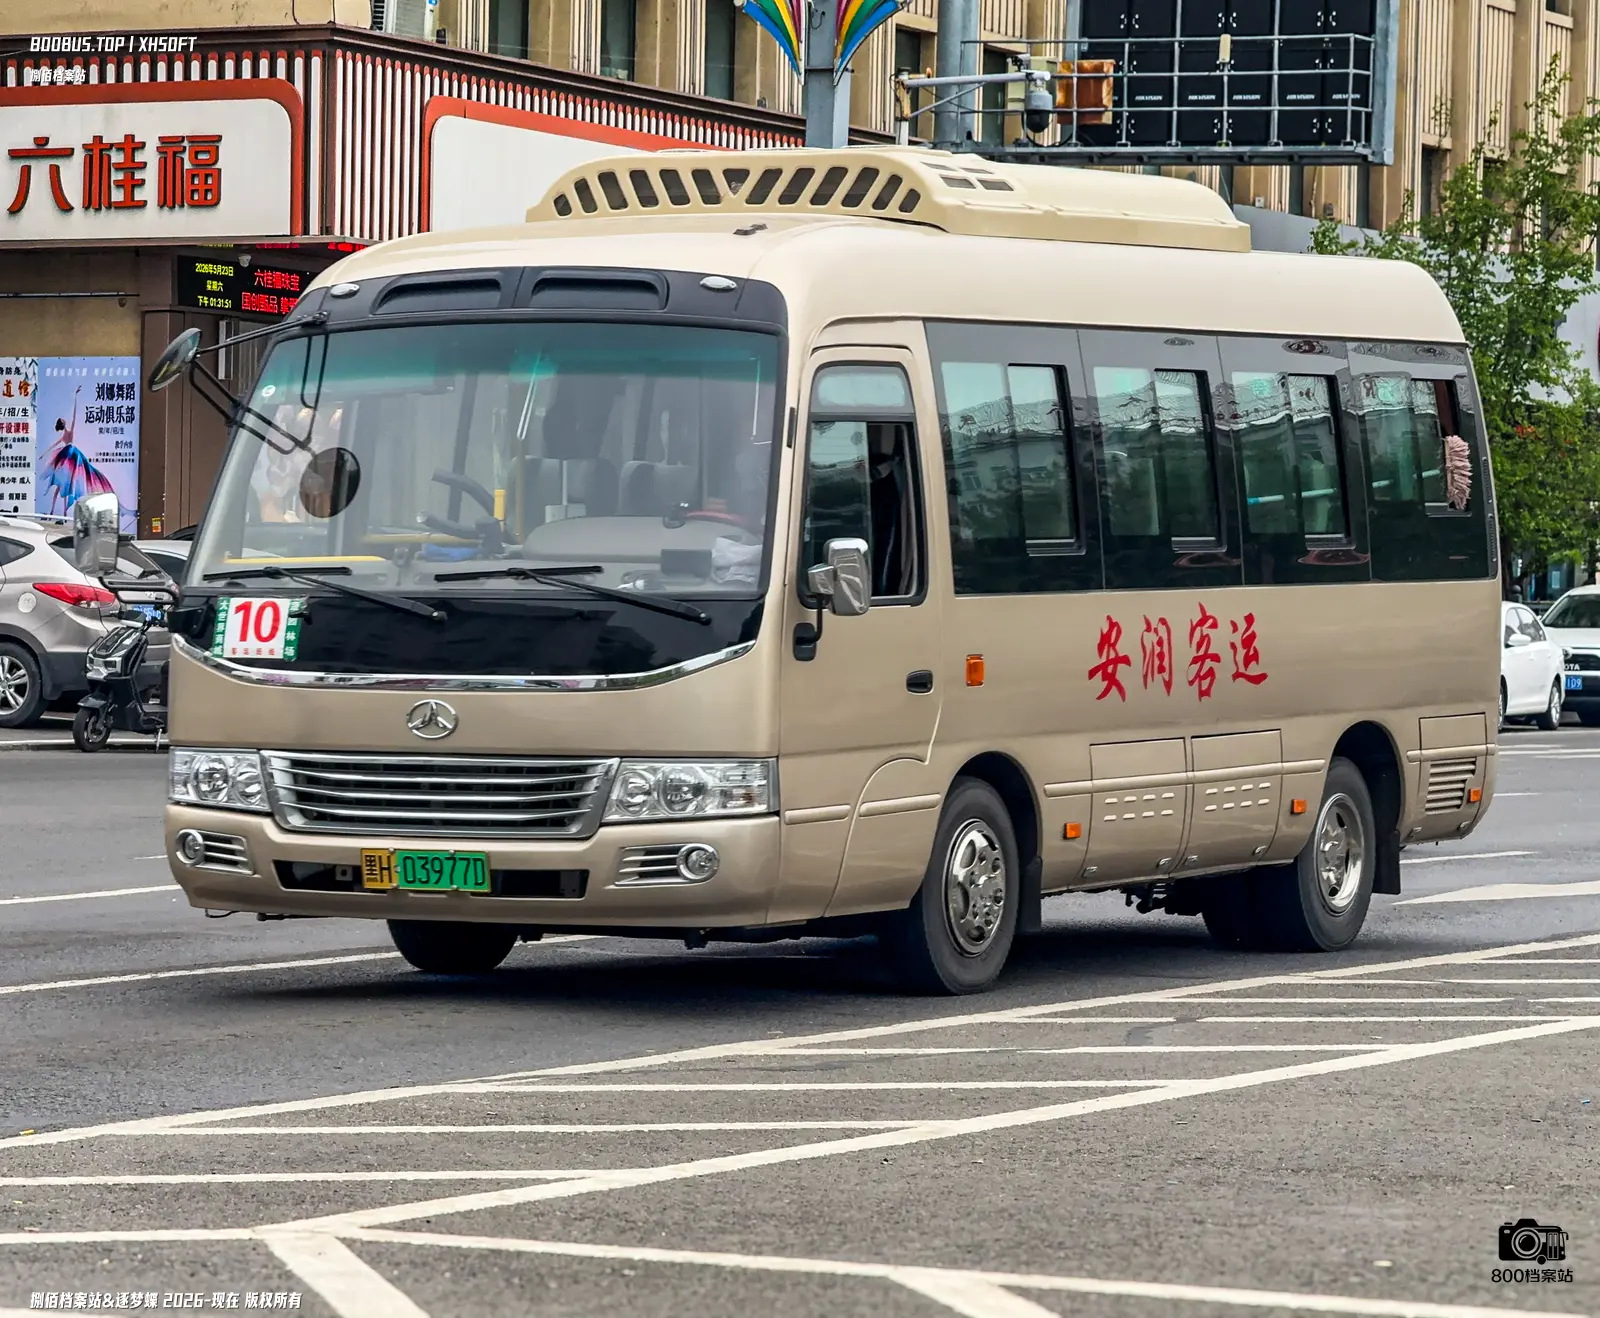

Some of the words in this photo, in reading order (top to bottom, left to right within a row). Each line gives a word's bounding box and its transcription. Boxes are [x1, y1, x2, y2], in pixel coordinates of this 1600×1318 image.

[7, 134, 223, 215] 六桂福
[195, 263, 234, 277] 2026年5月23日
[254, 269, 300, 291] 六桂福珠宝
[206, 280, 224, 292] 星期六
[197, 295, 209, 307] 下午
[95, 382, 136, 402] 刘娜舞蹈
[84, 405, 136, 424] 运动俱乐部
[234, 600, 281, 643] 10
[1087, 601, 1269, 703] 安润客运
